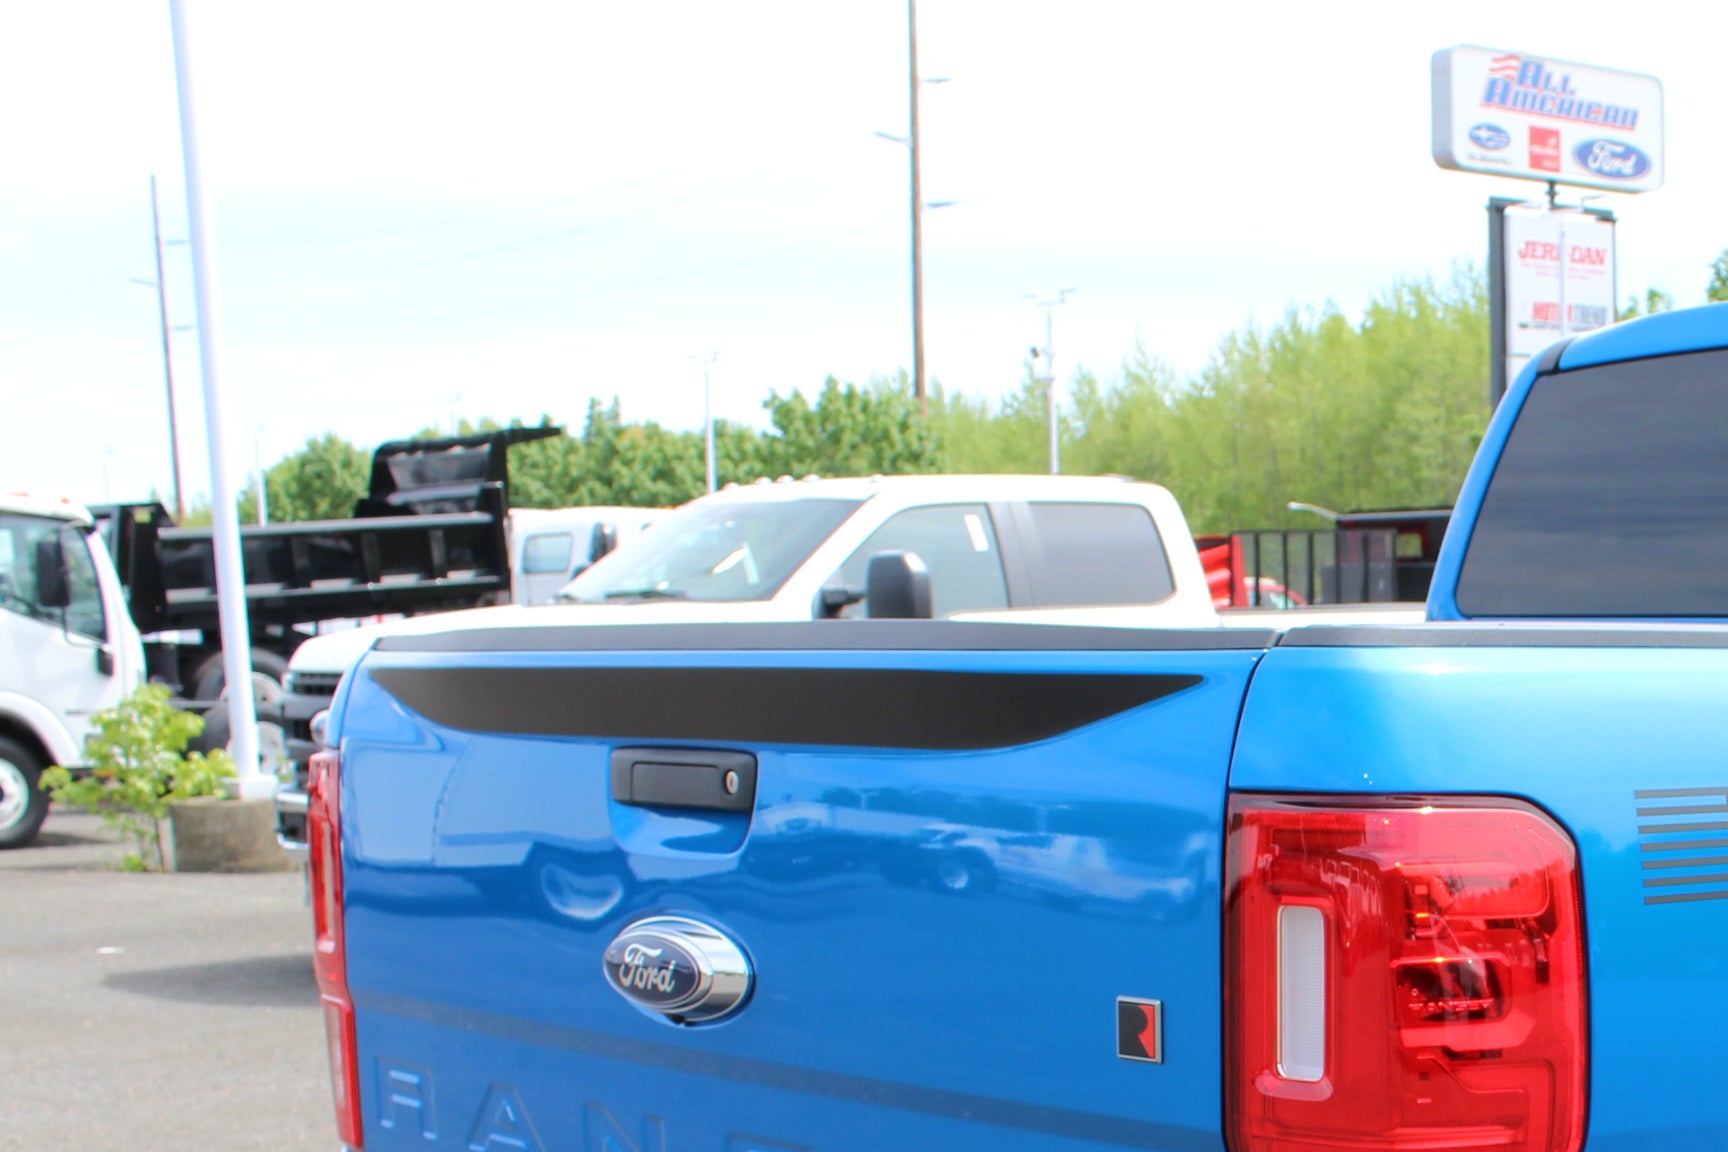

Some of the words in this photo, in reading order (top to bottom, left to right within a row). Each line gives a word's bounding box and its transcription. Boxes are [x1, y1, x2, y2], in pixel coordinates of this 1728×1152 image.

[1483, 77, 1640, 128] AMERICAN
[1587, 140, 1638, 176] Ford
[619, 943, 677, 993] Ford
